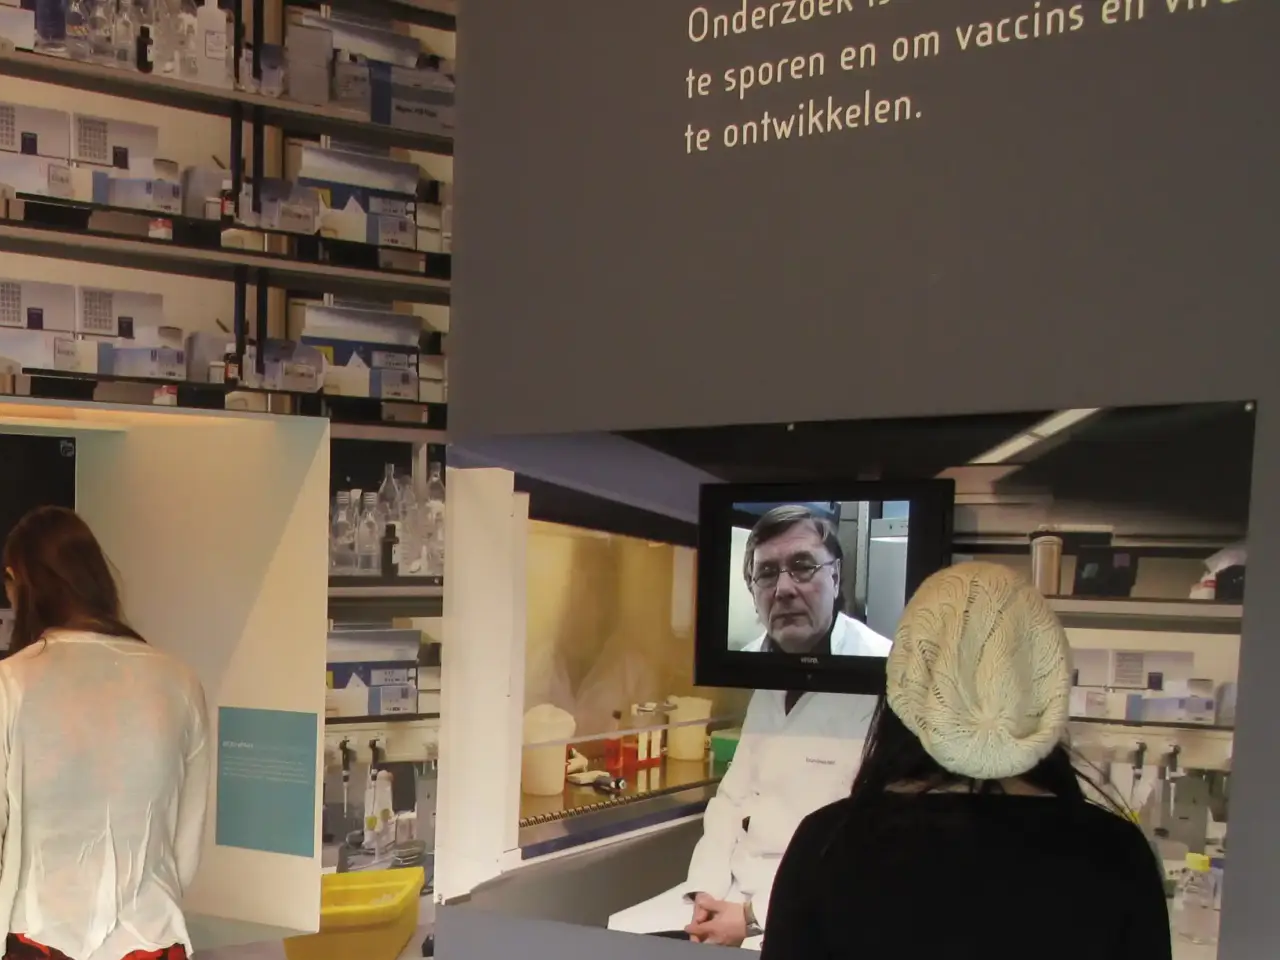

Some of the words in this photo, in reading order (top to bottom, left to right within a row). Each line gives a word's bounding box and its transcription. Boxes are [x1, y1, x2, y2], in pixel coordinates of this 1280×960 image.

[686, 68, 712, 99] te
[724, 52, 825, 101] sporen
[840, 43, 876, 70] en
[892, 31, 940, 61] om
[956, 1, 1085, 51] vaccins
[684, 123, 711, 154] te
[724, 89, 922, 148] ontwikkelen.
